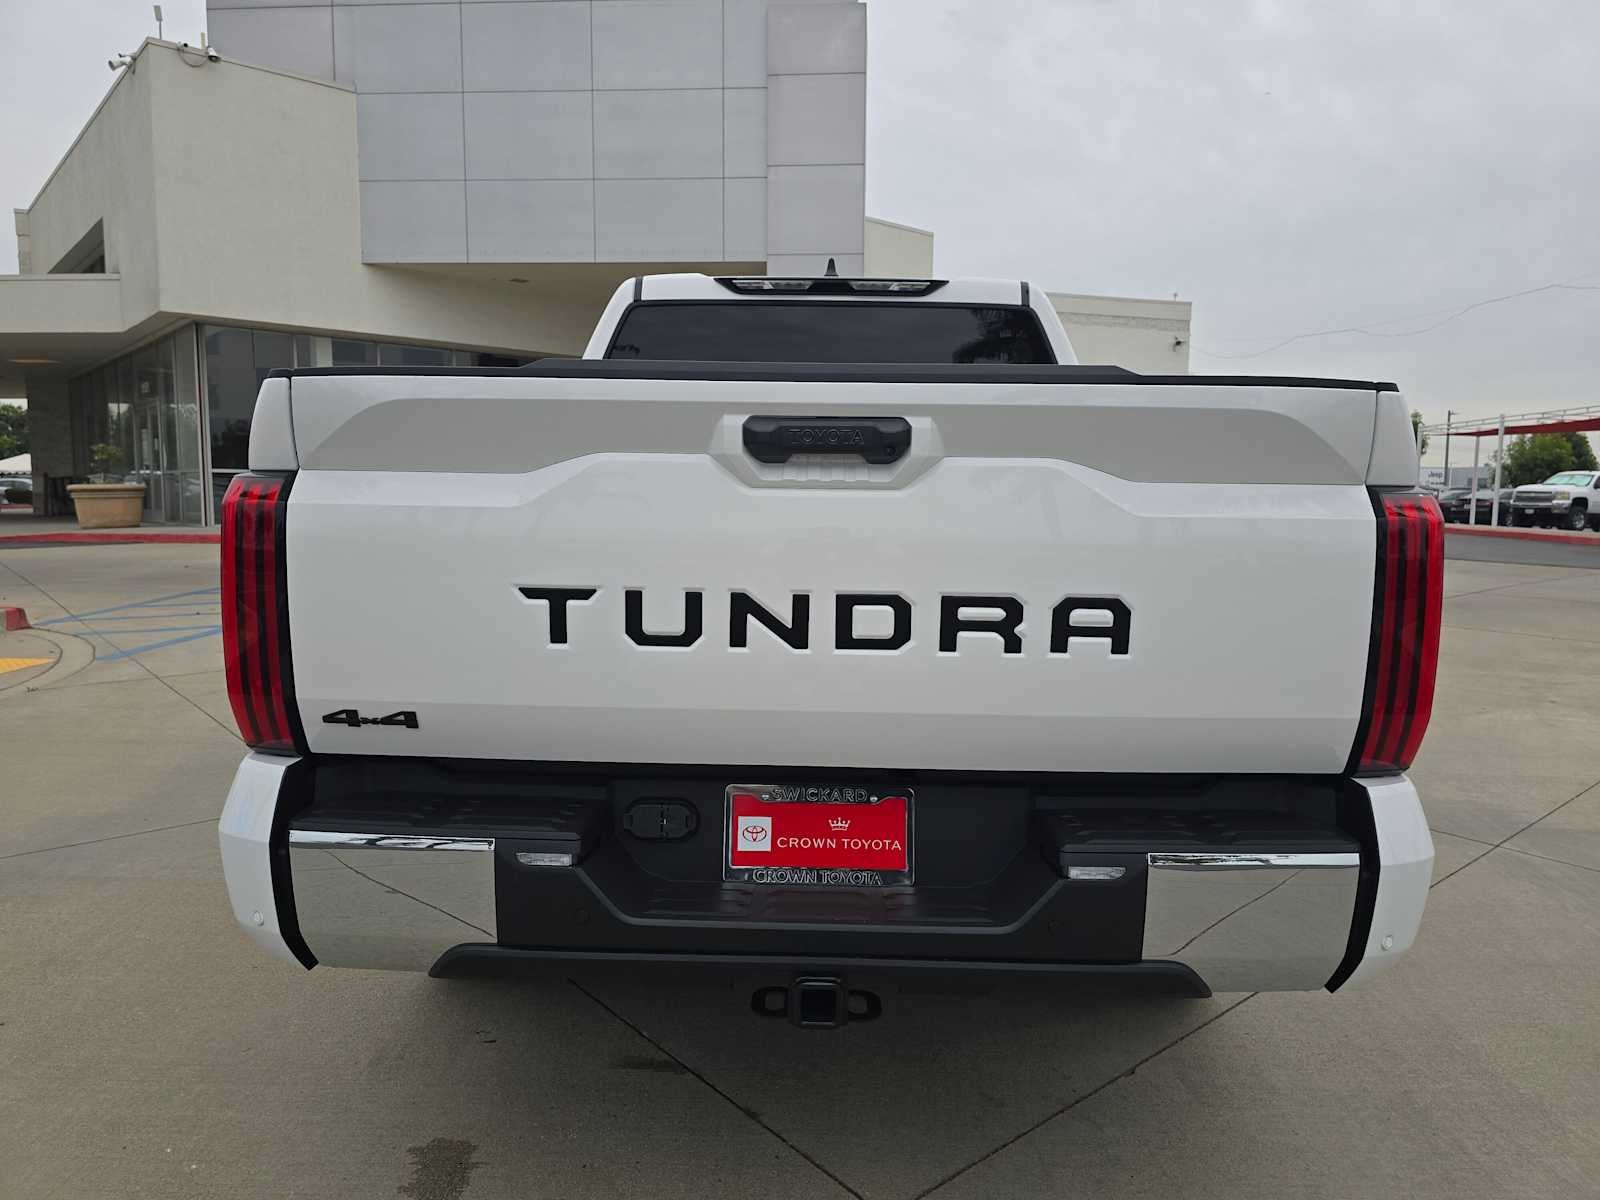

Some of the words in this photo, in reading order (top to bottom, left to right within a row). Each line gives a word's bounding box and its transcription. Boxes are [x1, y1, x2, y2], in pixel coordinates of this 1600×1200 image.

[786, 428, 865, 444] TOYOTA
[515, 586, 1132, 655] TUNDRA
[771, 787, 868, 803] SWICKARD
[777, 837, 836, 849] CROWN
[841, 838, 902, 850] TOYOTA
[752, 869, 817, 885] CROWN
[821, 870, 883, 886] TOYOTA
